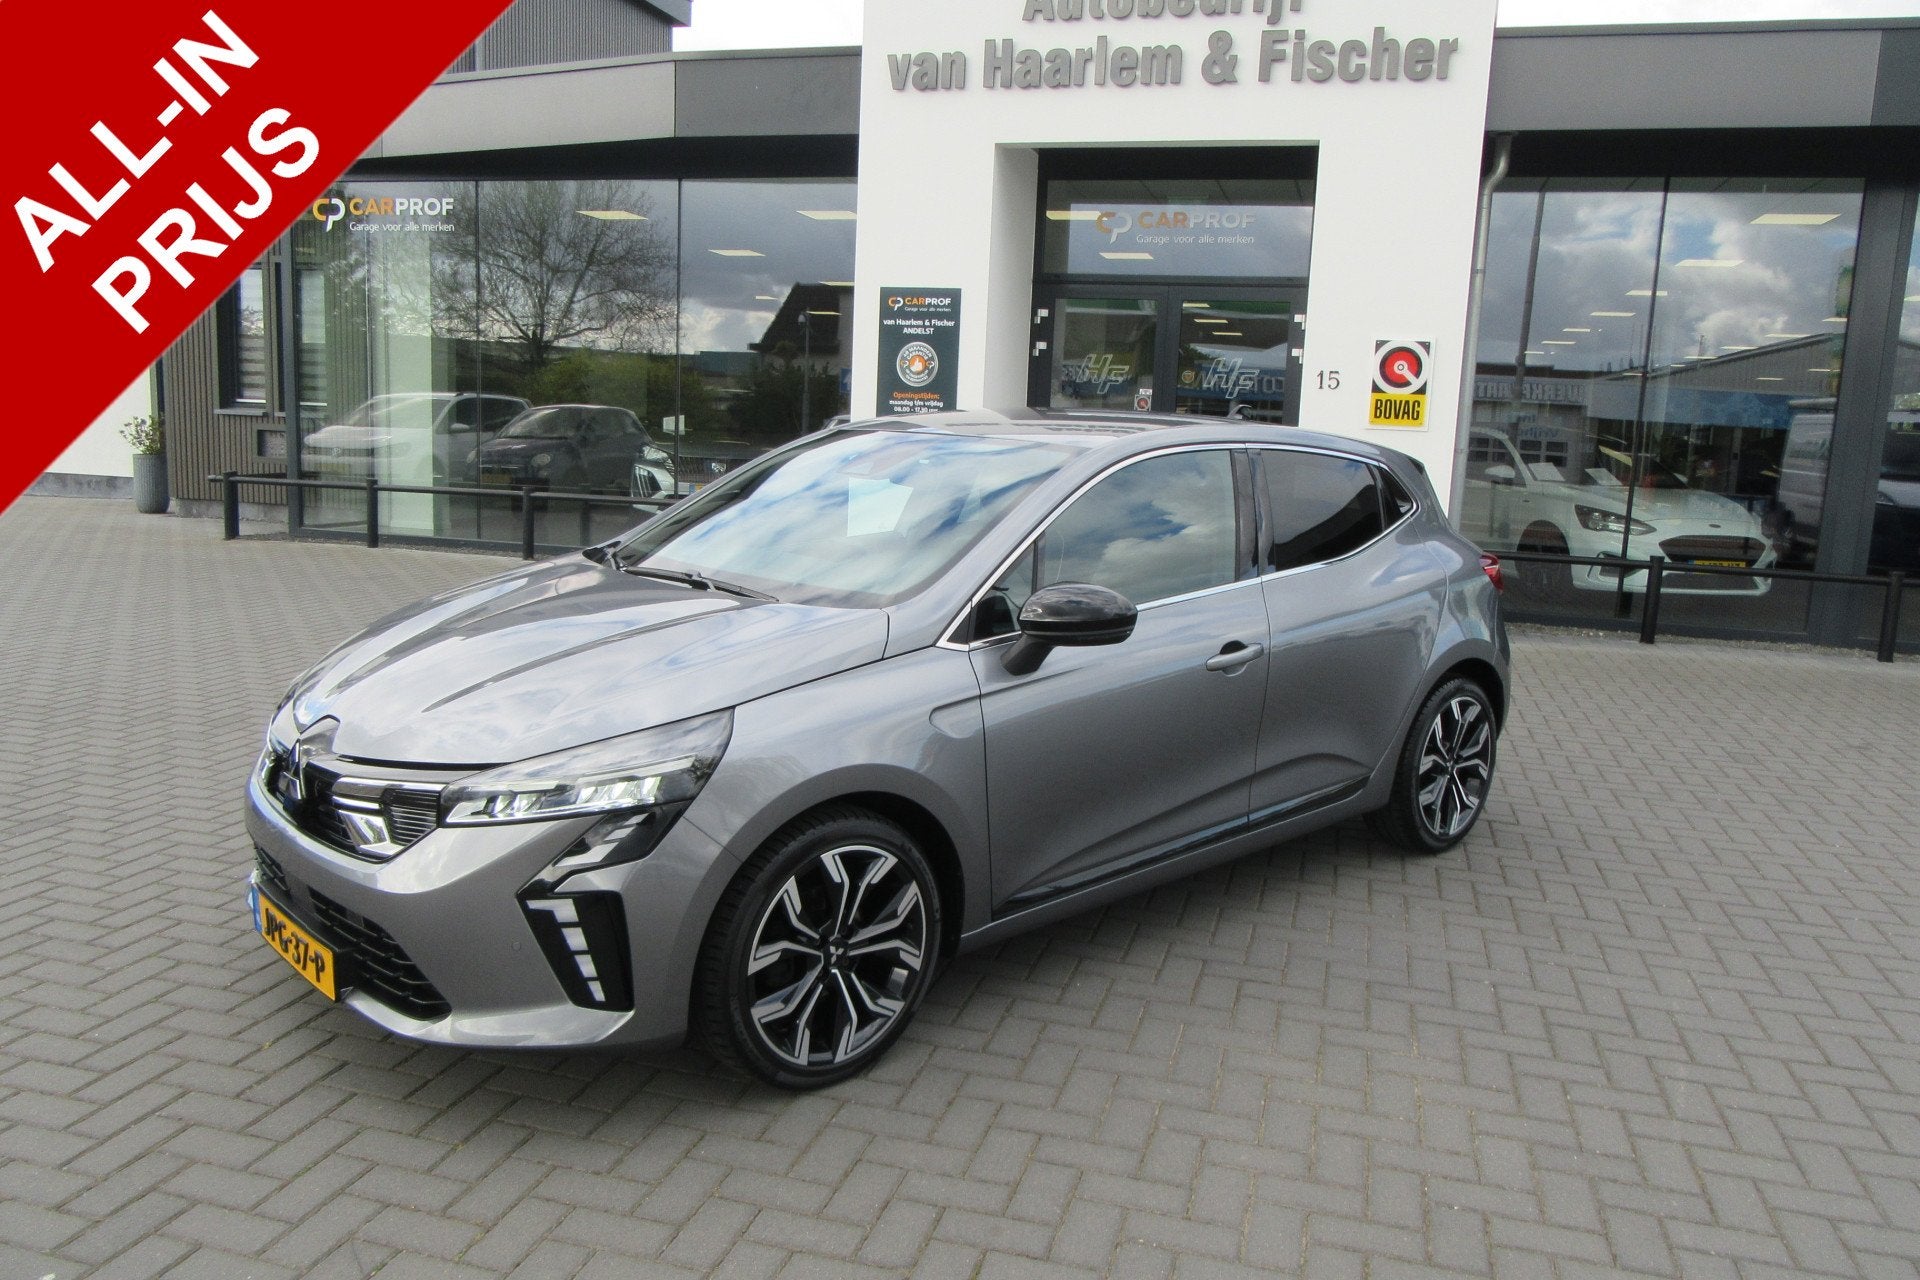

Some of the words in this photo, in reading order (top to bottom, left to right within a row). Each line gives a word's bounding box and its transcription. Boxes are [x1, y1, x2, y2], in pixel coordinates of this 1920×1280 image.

[887, 51, 967, 91] van
[983, 35, 1183, 90] Haarlem
[1201, 30, 1239, 85] &
[1258, 26, 1459, 83] Fischer
[349, 197, 455, 216] CARPROF
[350, 222, 380, 233] Garage
[382, 223, 402, 232] voor
[405, 222, 419, 232] alle
[422, 222, 455, 232] merken
[1137, 211, 1257, 229] CARPROF
[1136, 235, 1170, 246] Garage
[1173, 236, 1195, 244] voor
[1198, 235, 1215, 244] alle
[1218, 235, 1254, 244] merken
[904, 297, 952, 306] CARPROF
[896, 318, 924, 326] Haarlem
[931, 319, 955, 327] Fischer
[903, 327, 935, 335] ANDELST
[1317, 369, 1341, 391] 15
[1373, 398, 1421, 421] BOVAG
[265, 907, 325, 983] JPG-37-P
